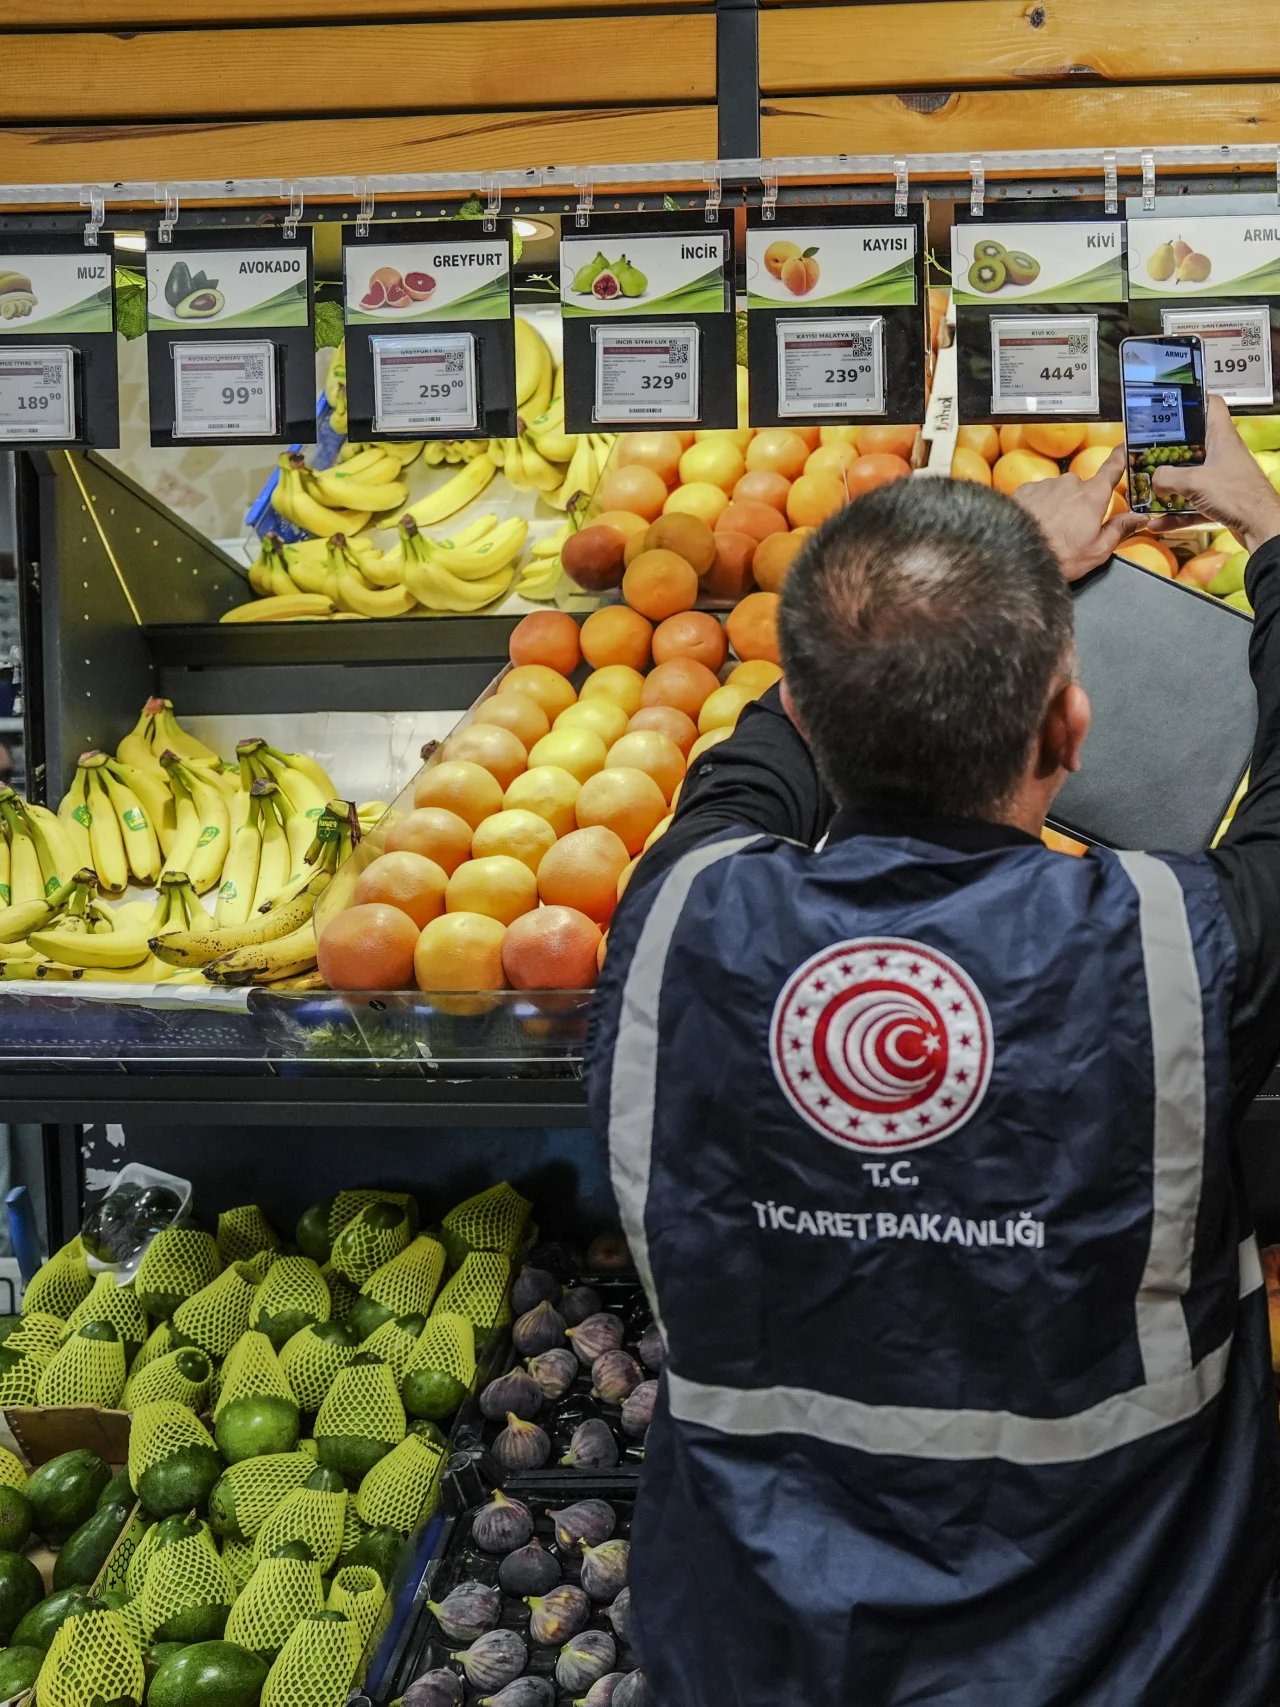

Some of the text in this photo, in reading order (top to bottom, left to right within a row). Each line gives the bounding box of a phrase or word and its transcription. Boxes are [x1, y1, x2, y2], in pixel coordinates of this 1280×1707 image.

[863, 238, 908, 252] KAYISI
[1087, 232, 1115, 248] KİVİ
[681, 243, 717, 259] İNCİR
[238, 259, 301, 274] AVOKADO
[433, 252, 502, 268] GREYFURT
[77, 267, 105, 280] MUZ
[1165, 350, 1188, 359] ARMUT
[862, 1160, 919, 1188] T.C.
[751, 1200, 1045, 1249] TİCARET BAKANLIĞI
